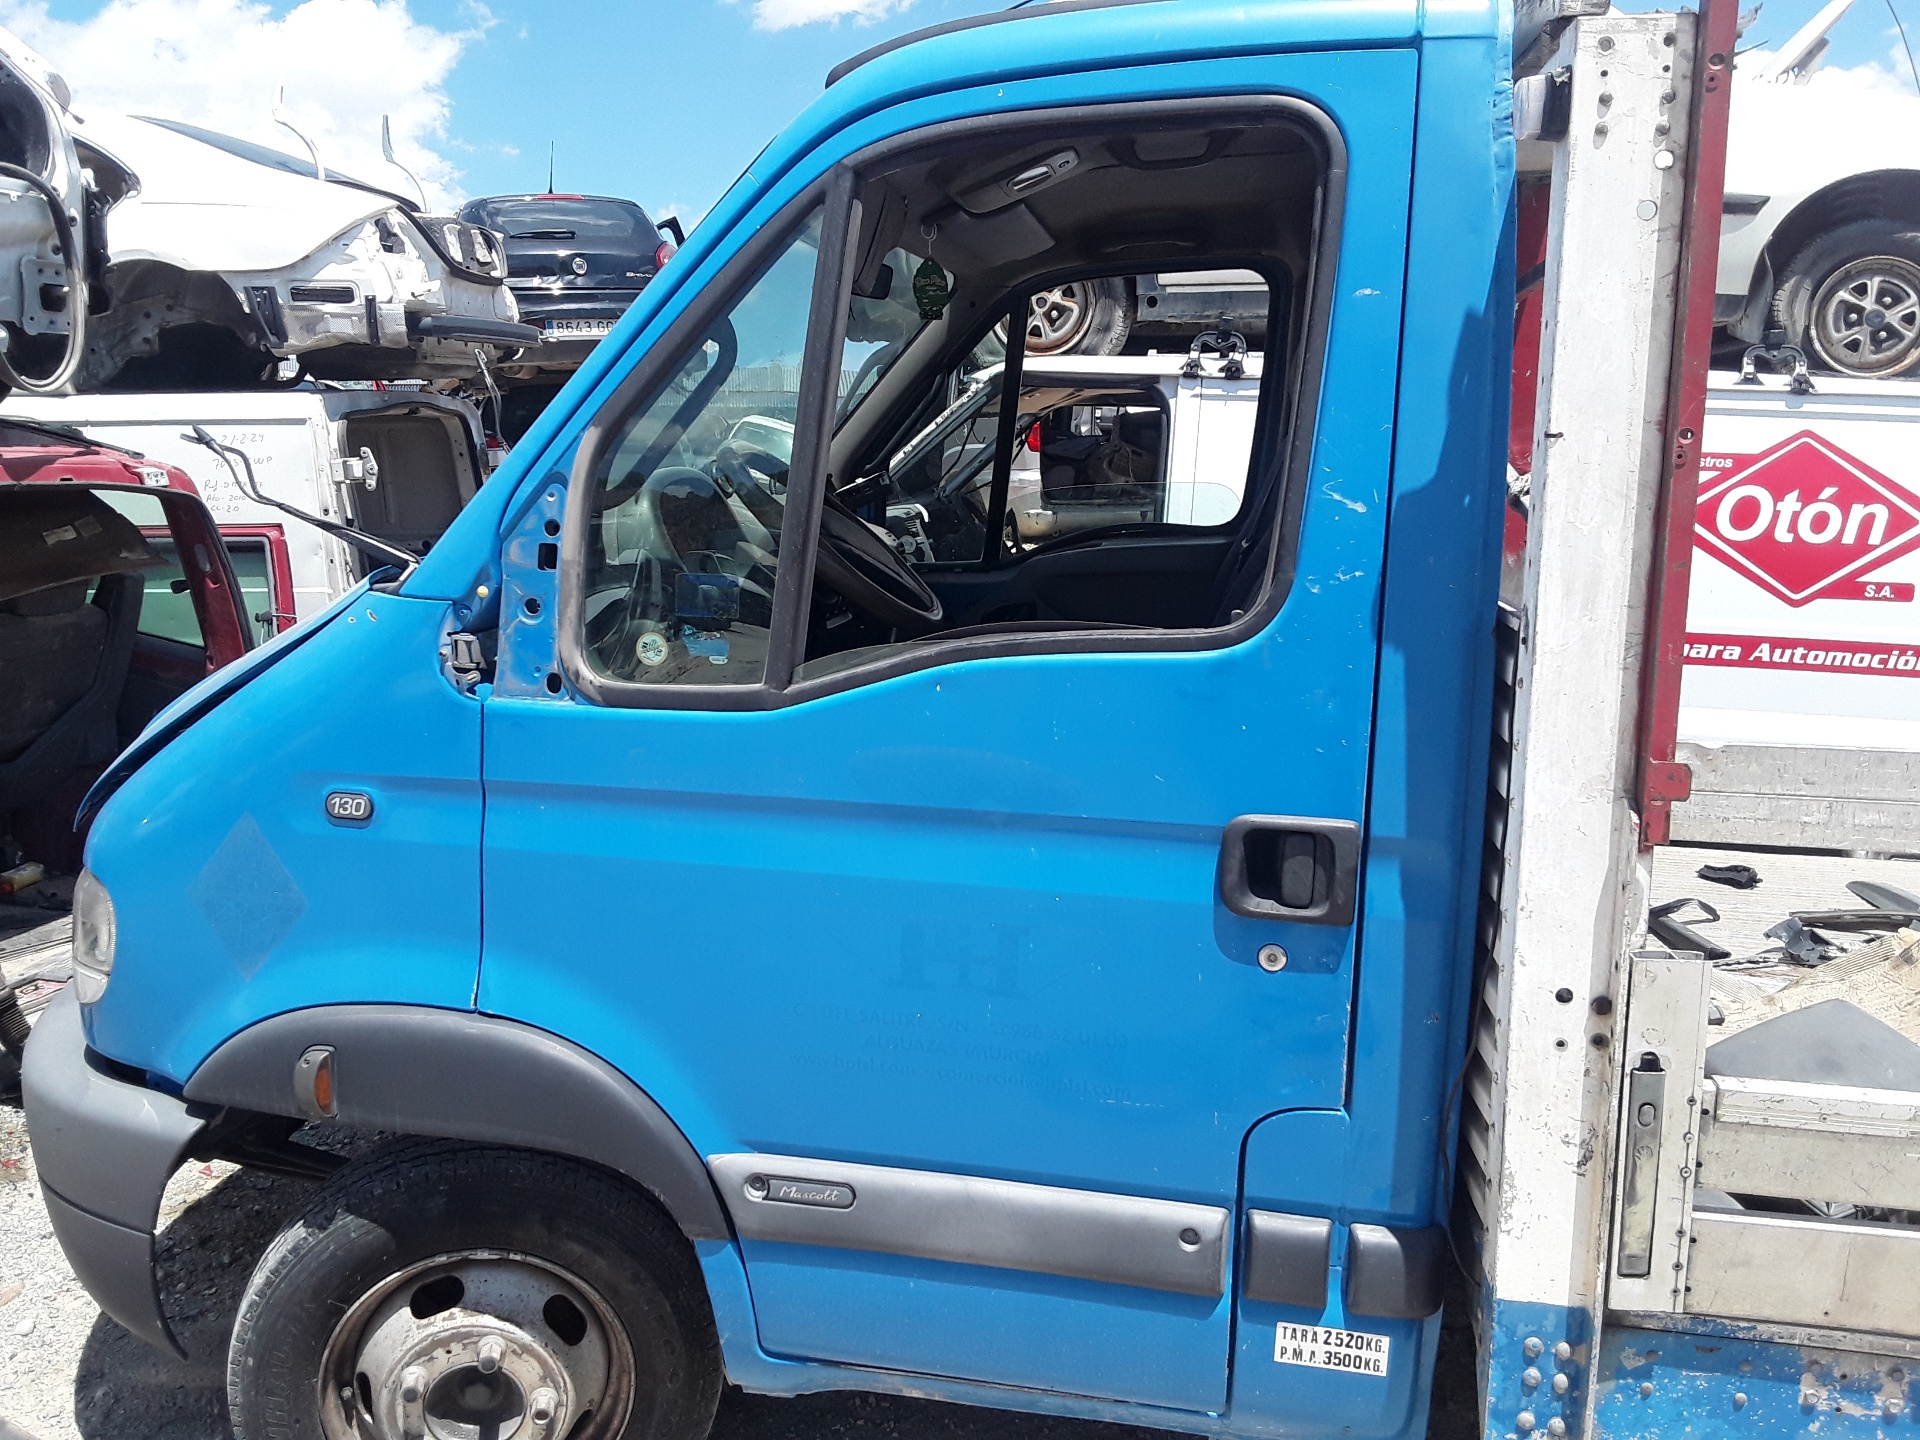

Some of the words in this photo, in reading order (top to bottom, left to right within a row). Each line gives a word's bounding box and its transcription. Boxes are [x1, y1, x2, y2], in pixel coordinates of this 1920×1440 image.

[556, 320, 592, 333] 8643
[1715, 484, 1890, 546] Otón
[1863, 584, 1895, 599] S.A.
[330, 797, 366, 816] 130
[779, 1185, 840, 1201] Mascott
[1281, 1325, 1319, 1344] TARA
